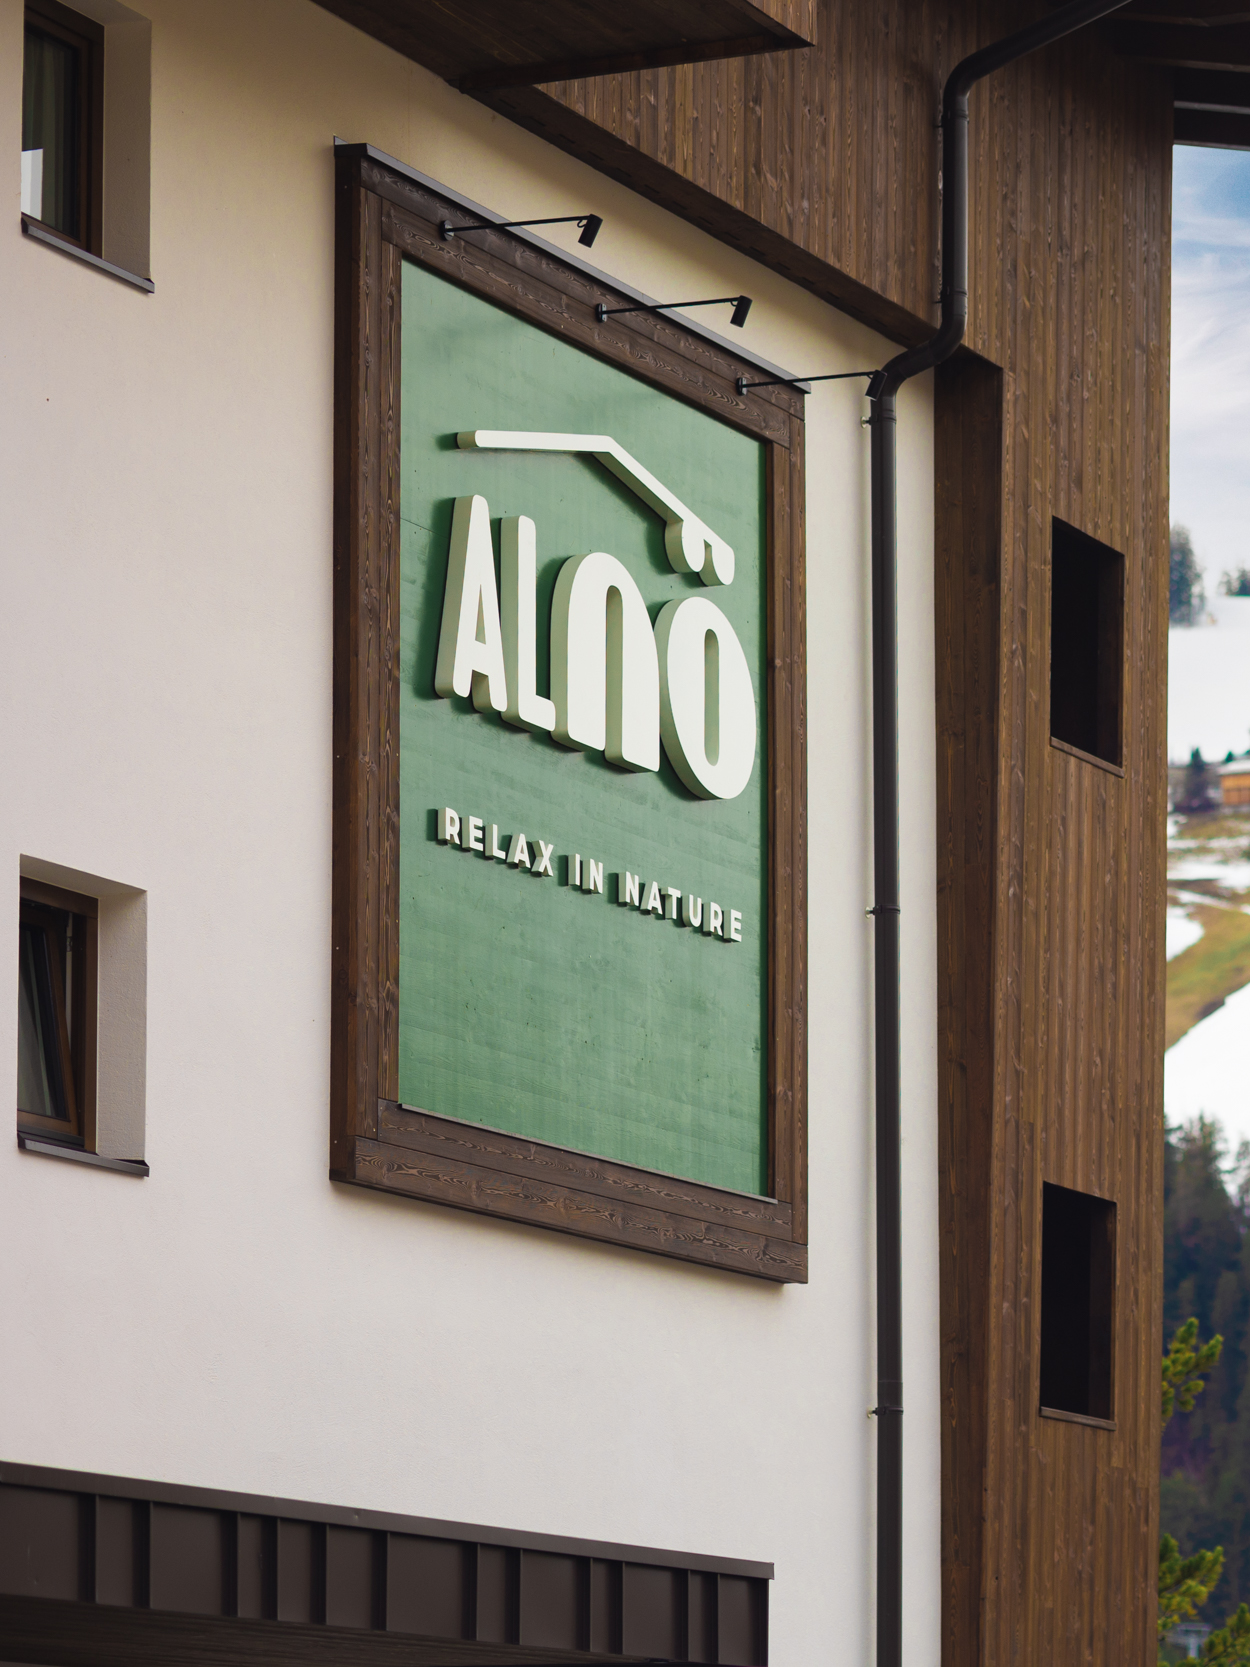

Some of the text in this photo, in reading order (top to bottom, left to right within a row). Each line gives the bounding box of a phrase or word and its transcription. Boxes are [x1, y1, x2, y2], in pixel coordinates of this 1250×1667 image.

[438, 807, 742, 942] RELAX IN NATURE
